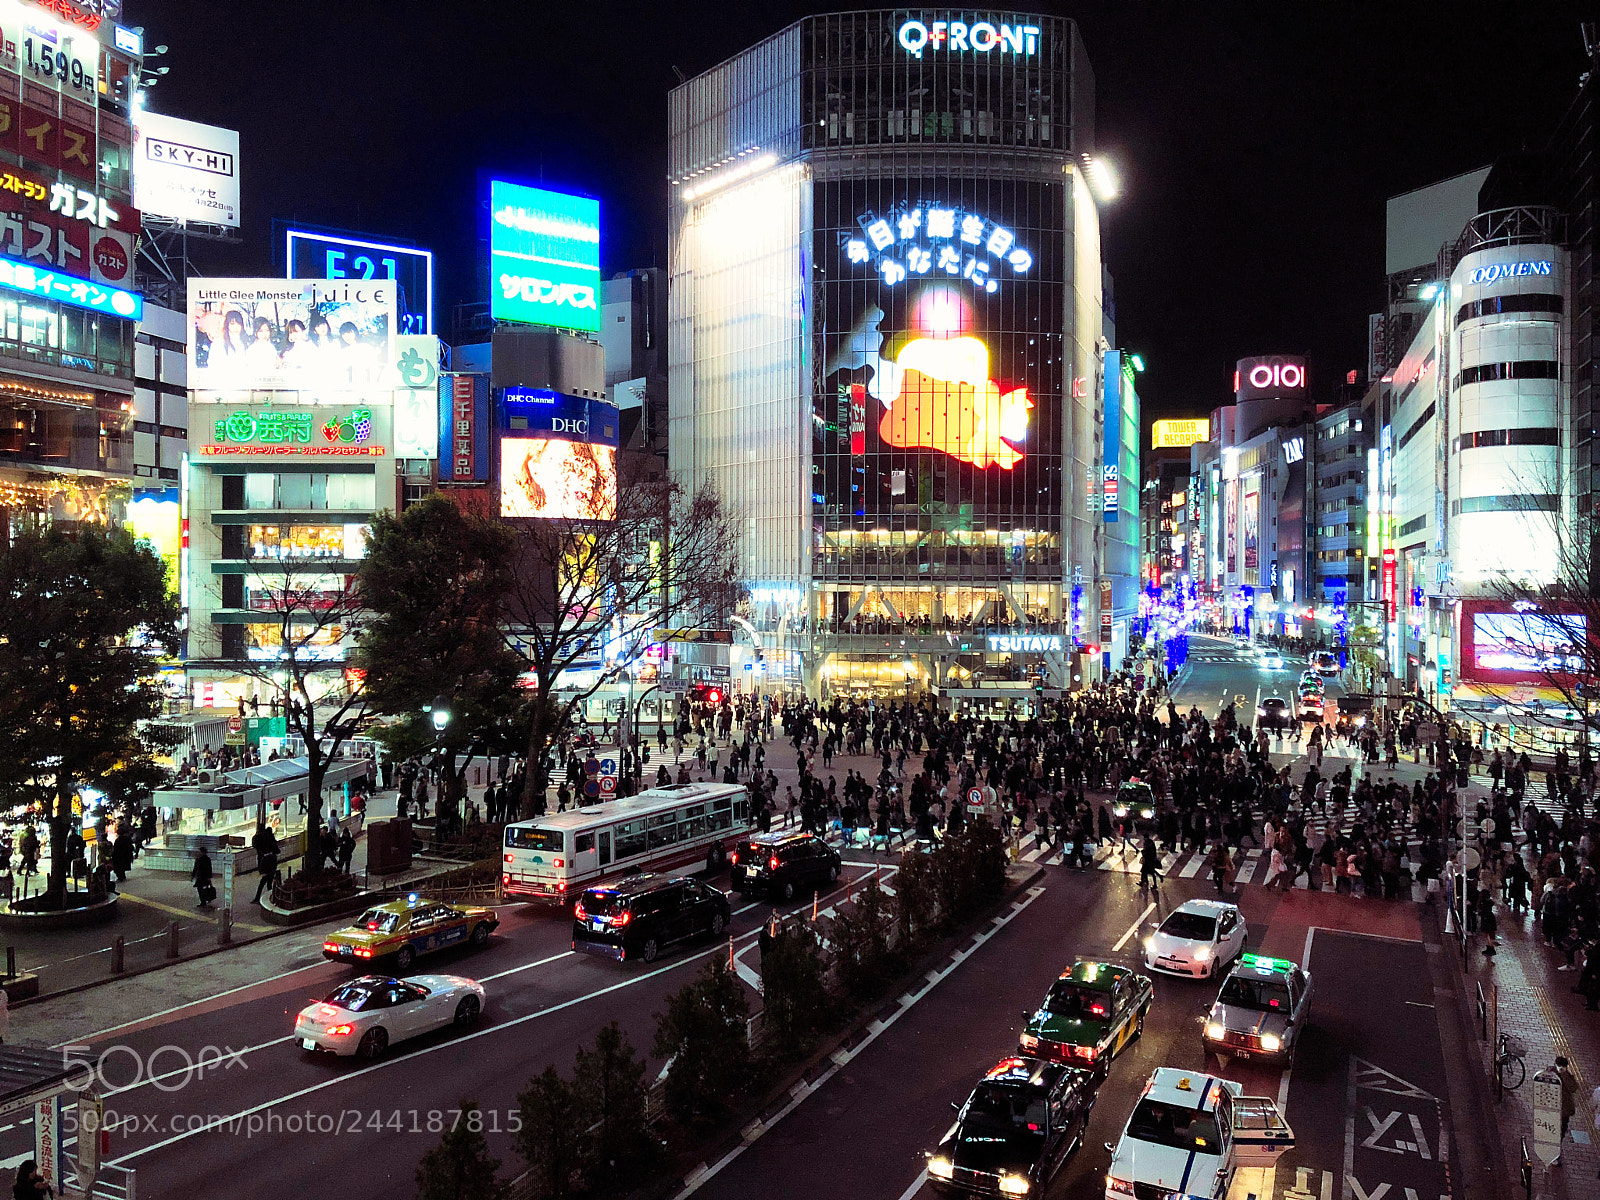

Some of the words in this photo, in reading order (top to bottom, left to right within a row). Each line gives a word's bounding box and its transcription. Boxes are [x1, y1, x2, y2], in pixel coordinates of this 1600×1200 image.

[25, 37, 94, 93] 1,599円
[153, 143, 227, 171] SKY-HI
[0, 172, 46, 200] ストラン
[50, 182, 119, 229] ガスト
[98, 253, 125, 270] ガスト
[199, 290, 227, 300] Little
[229, 290, 254, 300] Glee
[256, 290, 303, 300] Monster
[309, 283, 385, 309] juice
[499, 273, 597, 310] サロンパス
[507, 395, 525, 403] DHC
[525, 395, 555, 404] Channel
[258, 422, 313, 443] 西村
[552, 418, 588, 434] DHC
[1167, 421, 1197, 433] TOWER
[988, 636, 1062, 651] TSUTAYA
